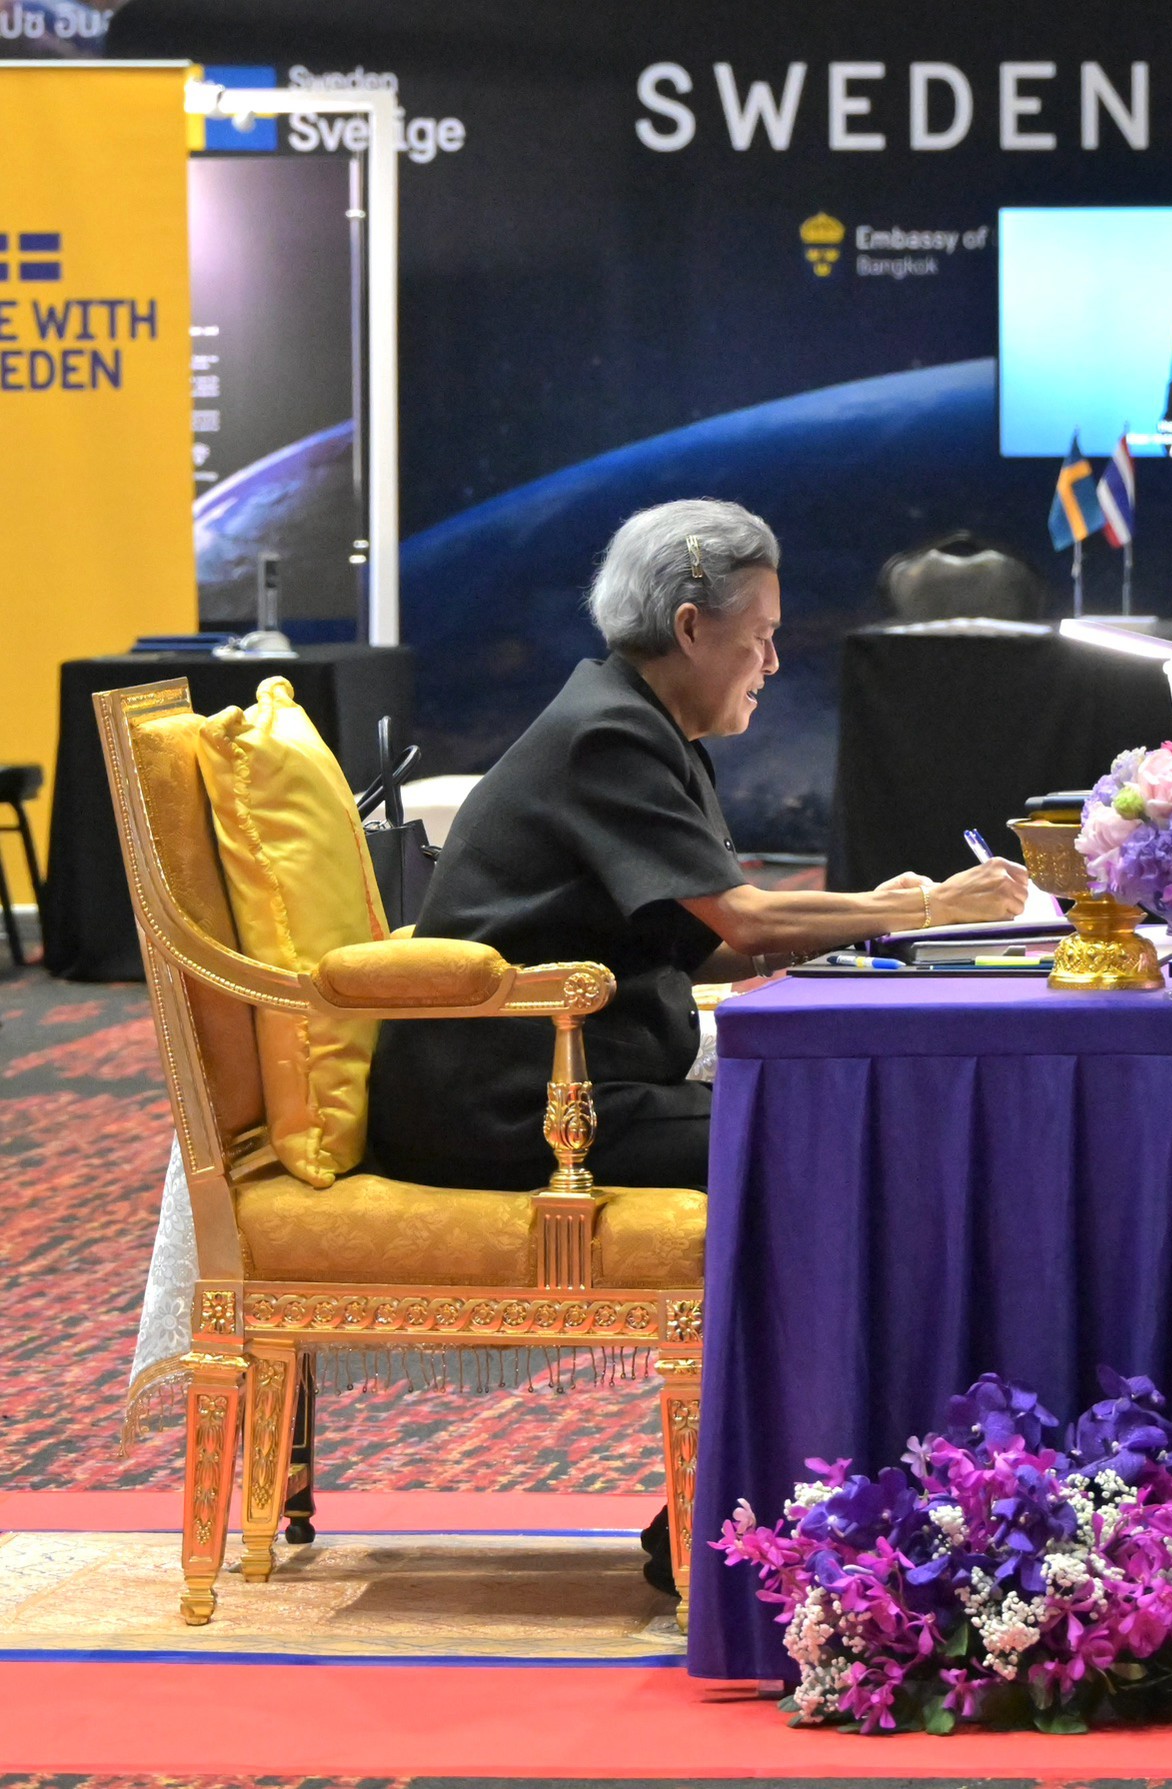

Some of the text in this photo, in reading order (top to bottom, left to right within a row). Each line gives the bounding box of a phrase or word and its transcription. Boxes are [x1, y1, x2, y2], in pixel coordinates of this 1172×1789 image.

[635, 60, 1149, 152] SWEDEN
[288, 105, 466, 164] Sveige
[855, 224, 989, 255] Embassy of
[32, 299, 158, 341] WITH
[0, 349, 122, 391] EDEN
